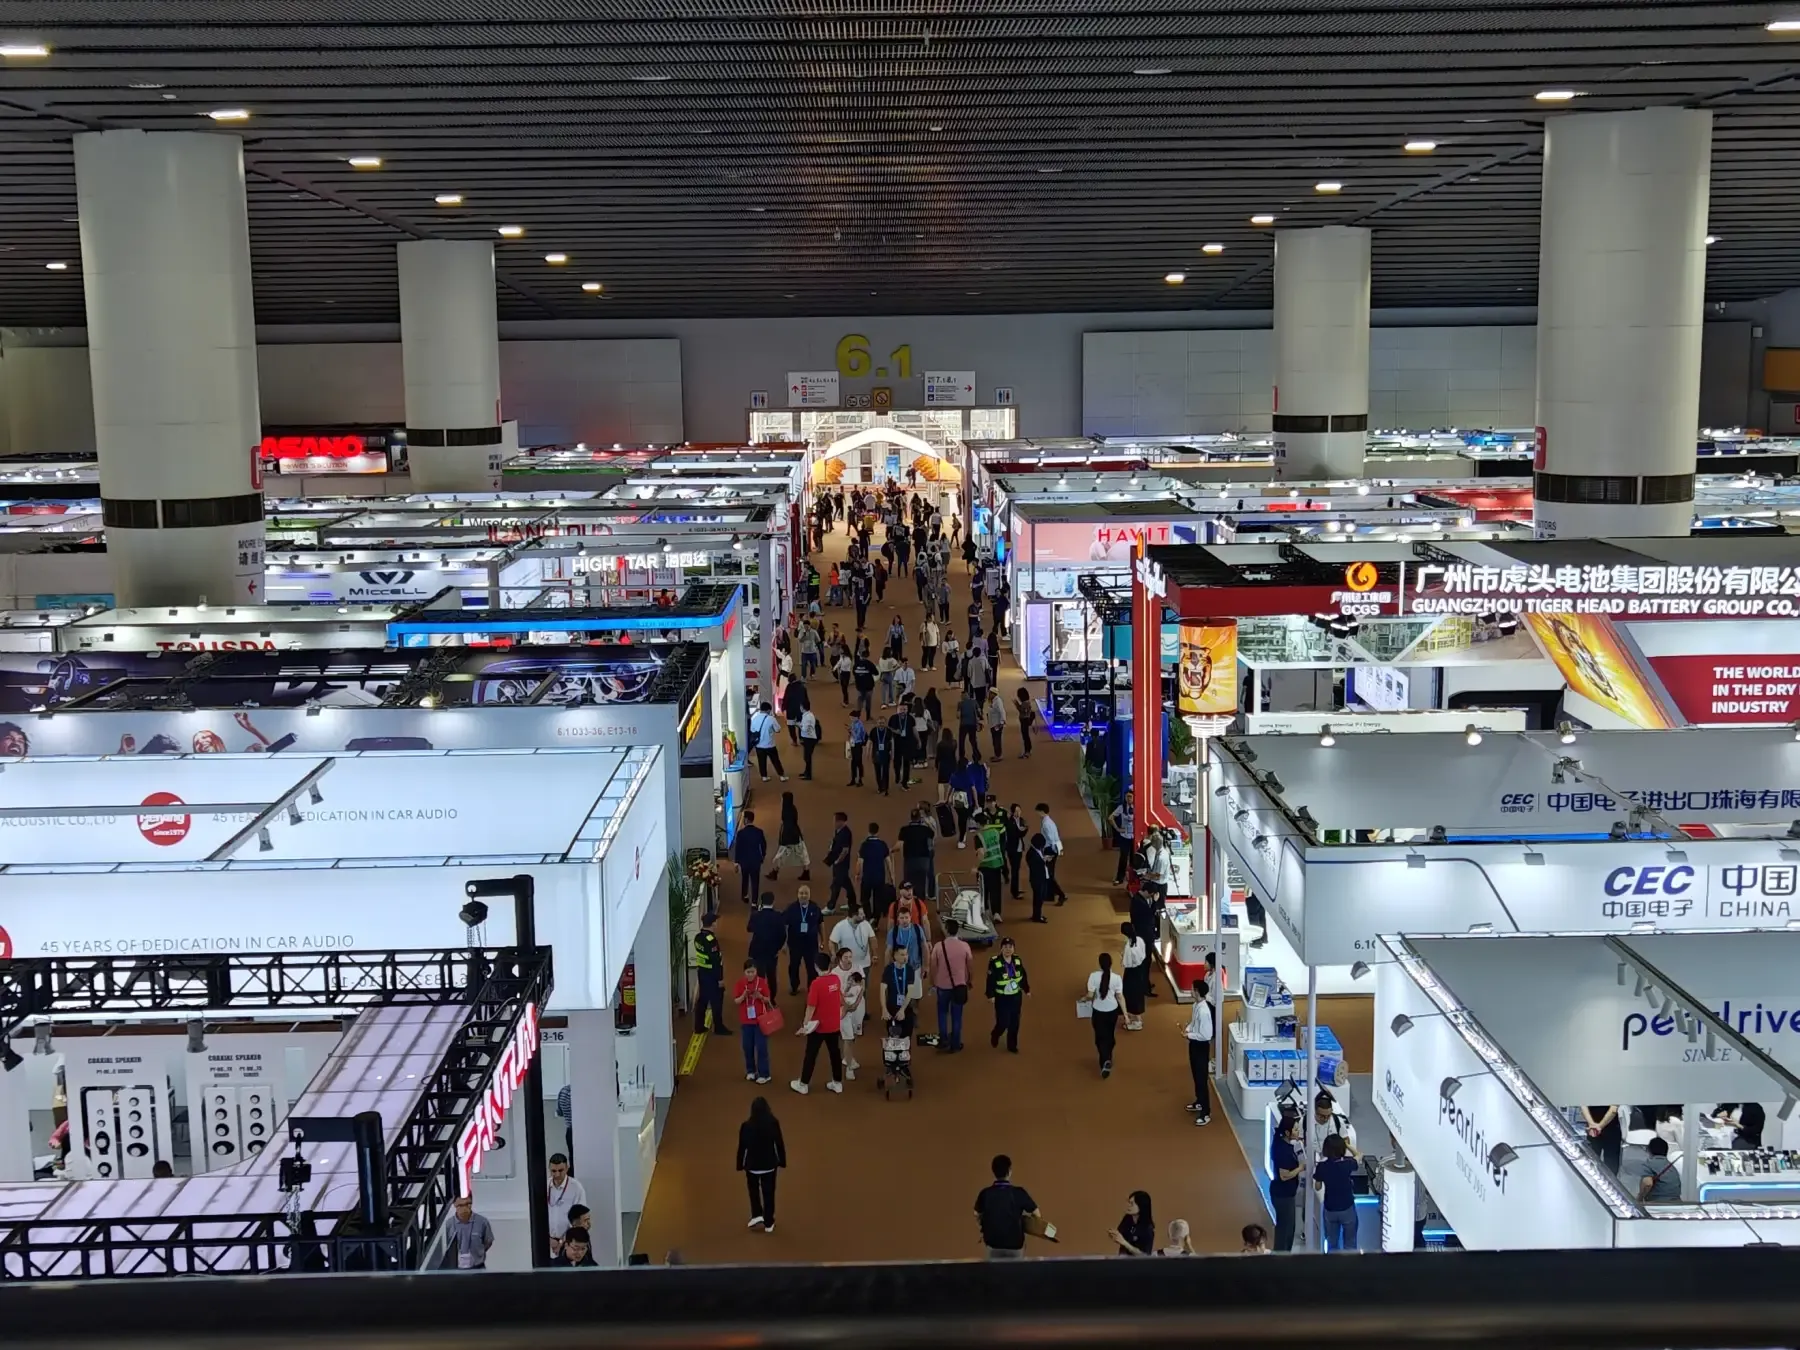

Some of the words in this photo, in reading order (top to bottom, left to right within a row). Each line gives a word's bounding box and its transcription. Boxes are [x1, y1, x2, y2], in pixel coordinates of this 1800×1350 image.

[835, 333, 912, 379] 6.1
[260, 435, 363, 459] ASANO
[1098, 527, 1169, 542] HAVIT
[1414, 563, 1800, 597] 广州市虎头电池集团股份有限公
[1340, 603, 1381, 615] GCGS
[1411, 598, 1523, 613] GUANGZHOU
[1525, 598, 1573, 613] TIGER
[1576, 598, 1625, 614] HEAD
[1627, 598, 1701, 614] BATTERY
[1702, 599, 1765, 614] GROUP
[1712, 666, 1745, 679] THE
[1746, 666, 1800, 679] WORLD
[1712, 684, 1729, 697] IN
[1731, 684, 1763, 696] THE
[1765, 684, 1797, 696] DRY
[1711, 700, 1790, 713] INDUSTRY
[1501, 793, 1534, 805] CEC
[300, 810, 368, 822] EDICATION
[370, 810, 385, 821] IN
[387, 809, 413, 820] CAR
[416, 808, 458, 820] AUDIO
[1603, 865, 1695, 897] CEC
[1721, 864, 1798, 896] 中国
[1602, 899, 1693, 919] 中国电子
[1719, 901, 1791, 917] CHINA
[40, 941, 59, 953] 45
[62, 939, 112, 953] YEARS
[141, 936, 240, 952] DEDICATION
[245, 936, 262, 949] IN
[266, 935, 297, 949] CAR
[302, 934, 355, 948] AUDIO
